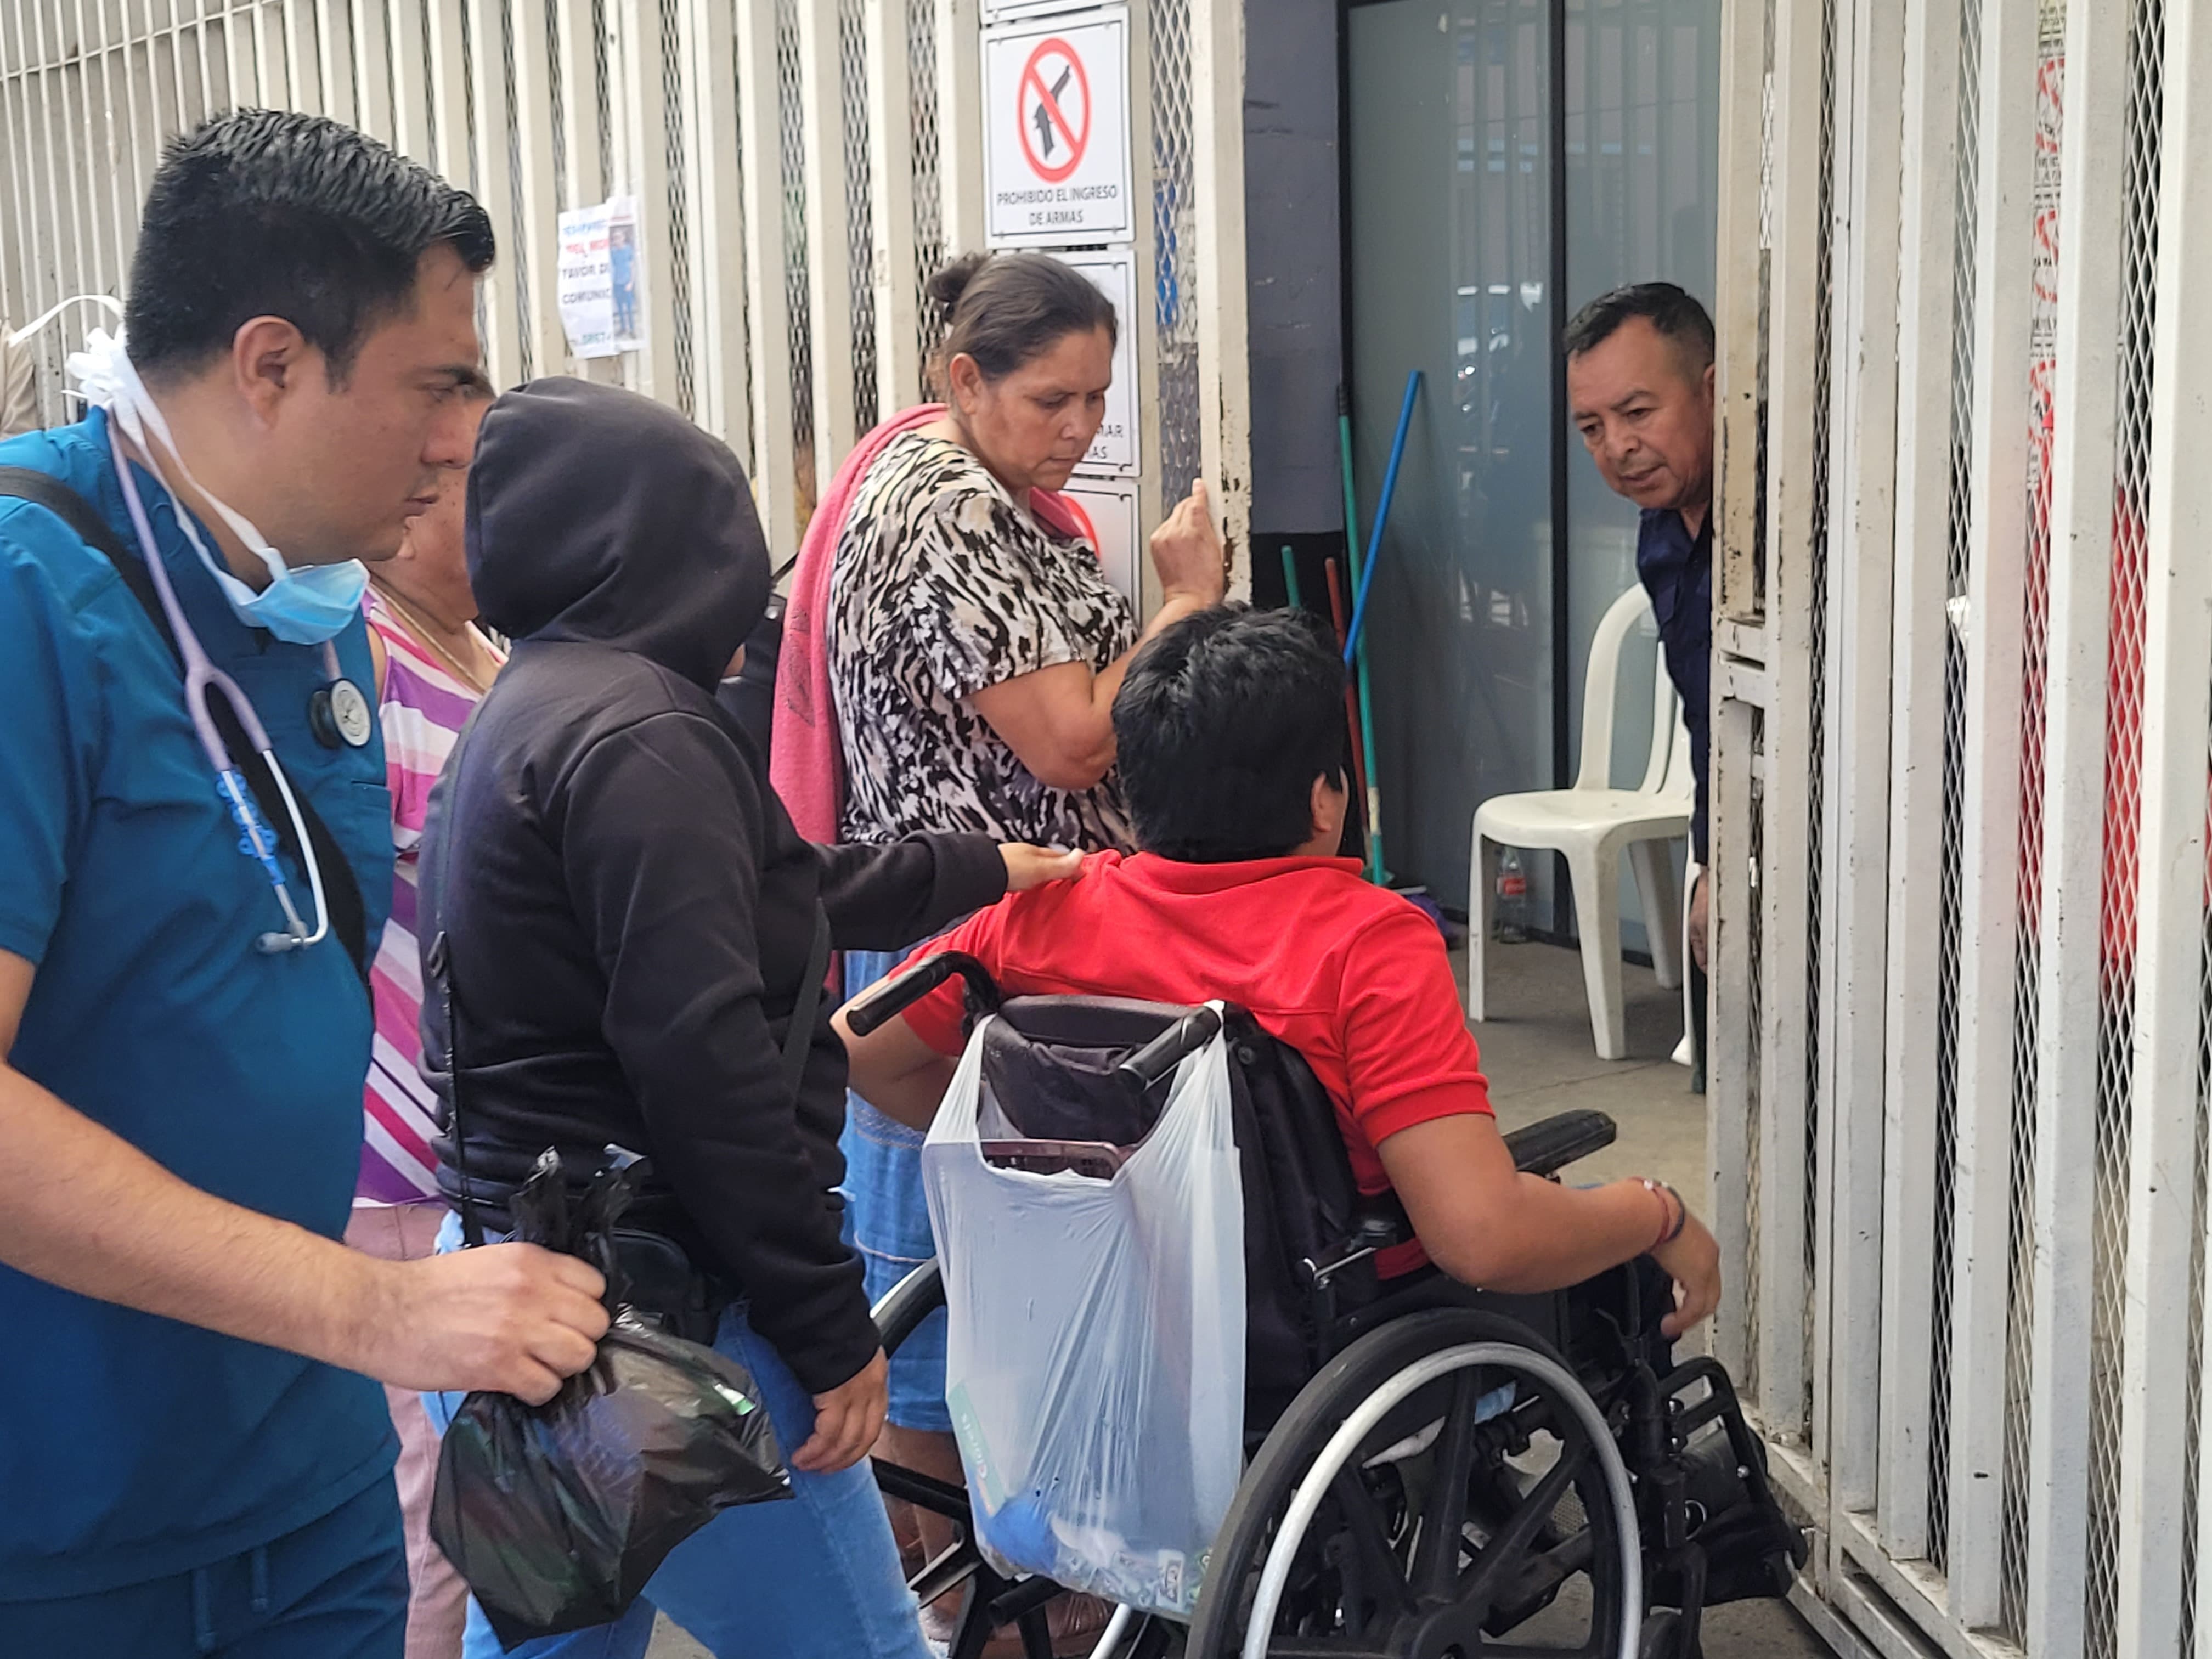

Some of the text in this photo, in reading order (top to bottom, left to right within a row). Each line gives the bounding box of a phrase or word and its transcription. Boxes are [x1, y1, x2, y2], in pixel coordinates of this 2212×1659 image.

[997, 185, 1117, 205] PROHIBIDO EL INGRESO
[1030, 210, 1084, 225] DE ARMAS
